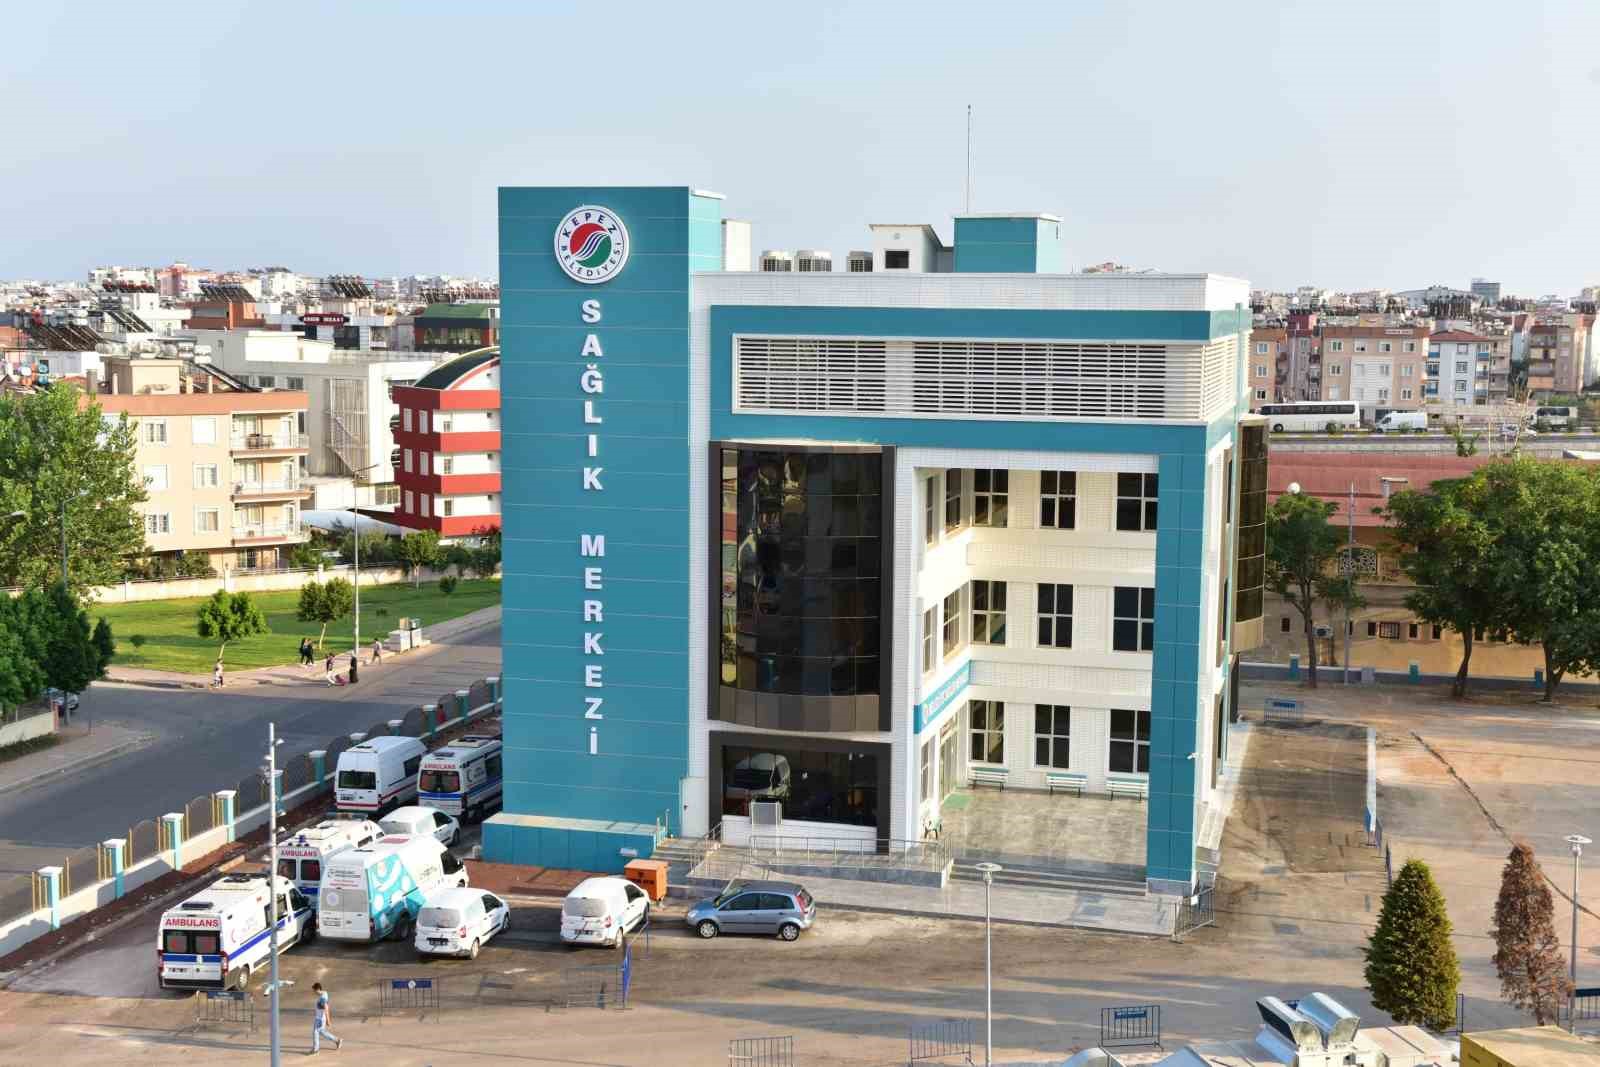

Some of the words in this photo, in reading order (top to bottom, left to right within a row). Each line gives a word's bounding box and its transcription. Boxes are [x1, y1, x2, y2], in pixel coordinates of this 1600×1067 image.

[561, 212, 617, 238] KEPEZ
[580, 299, 604, 491] SAĞLIK
[580, 534, 605, 755] MERKEZİ
[281, 849, 318, 857] AMBULANS
[165, 918, 219, 927] AMBULANS
